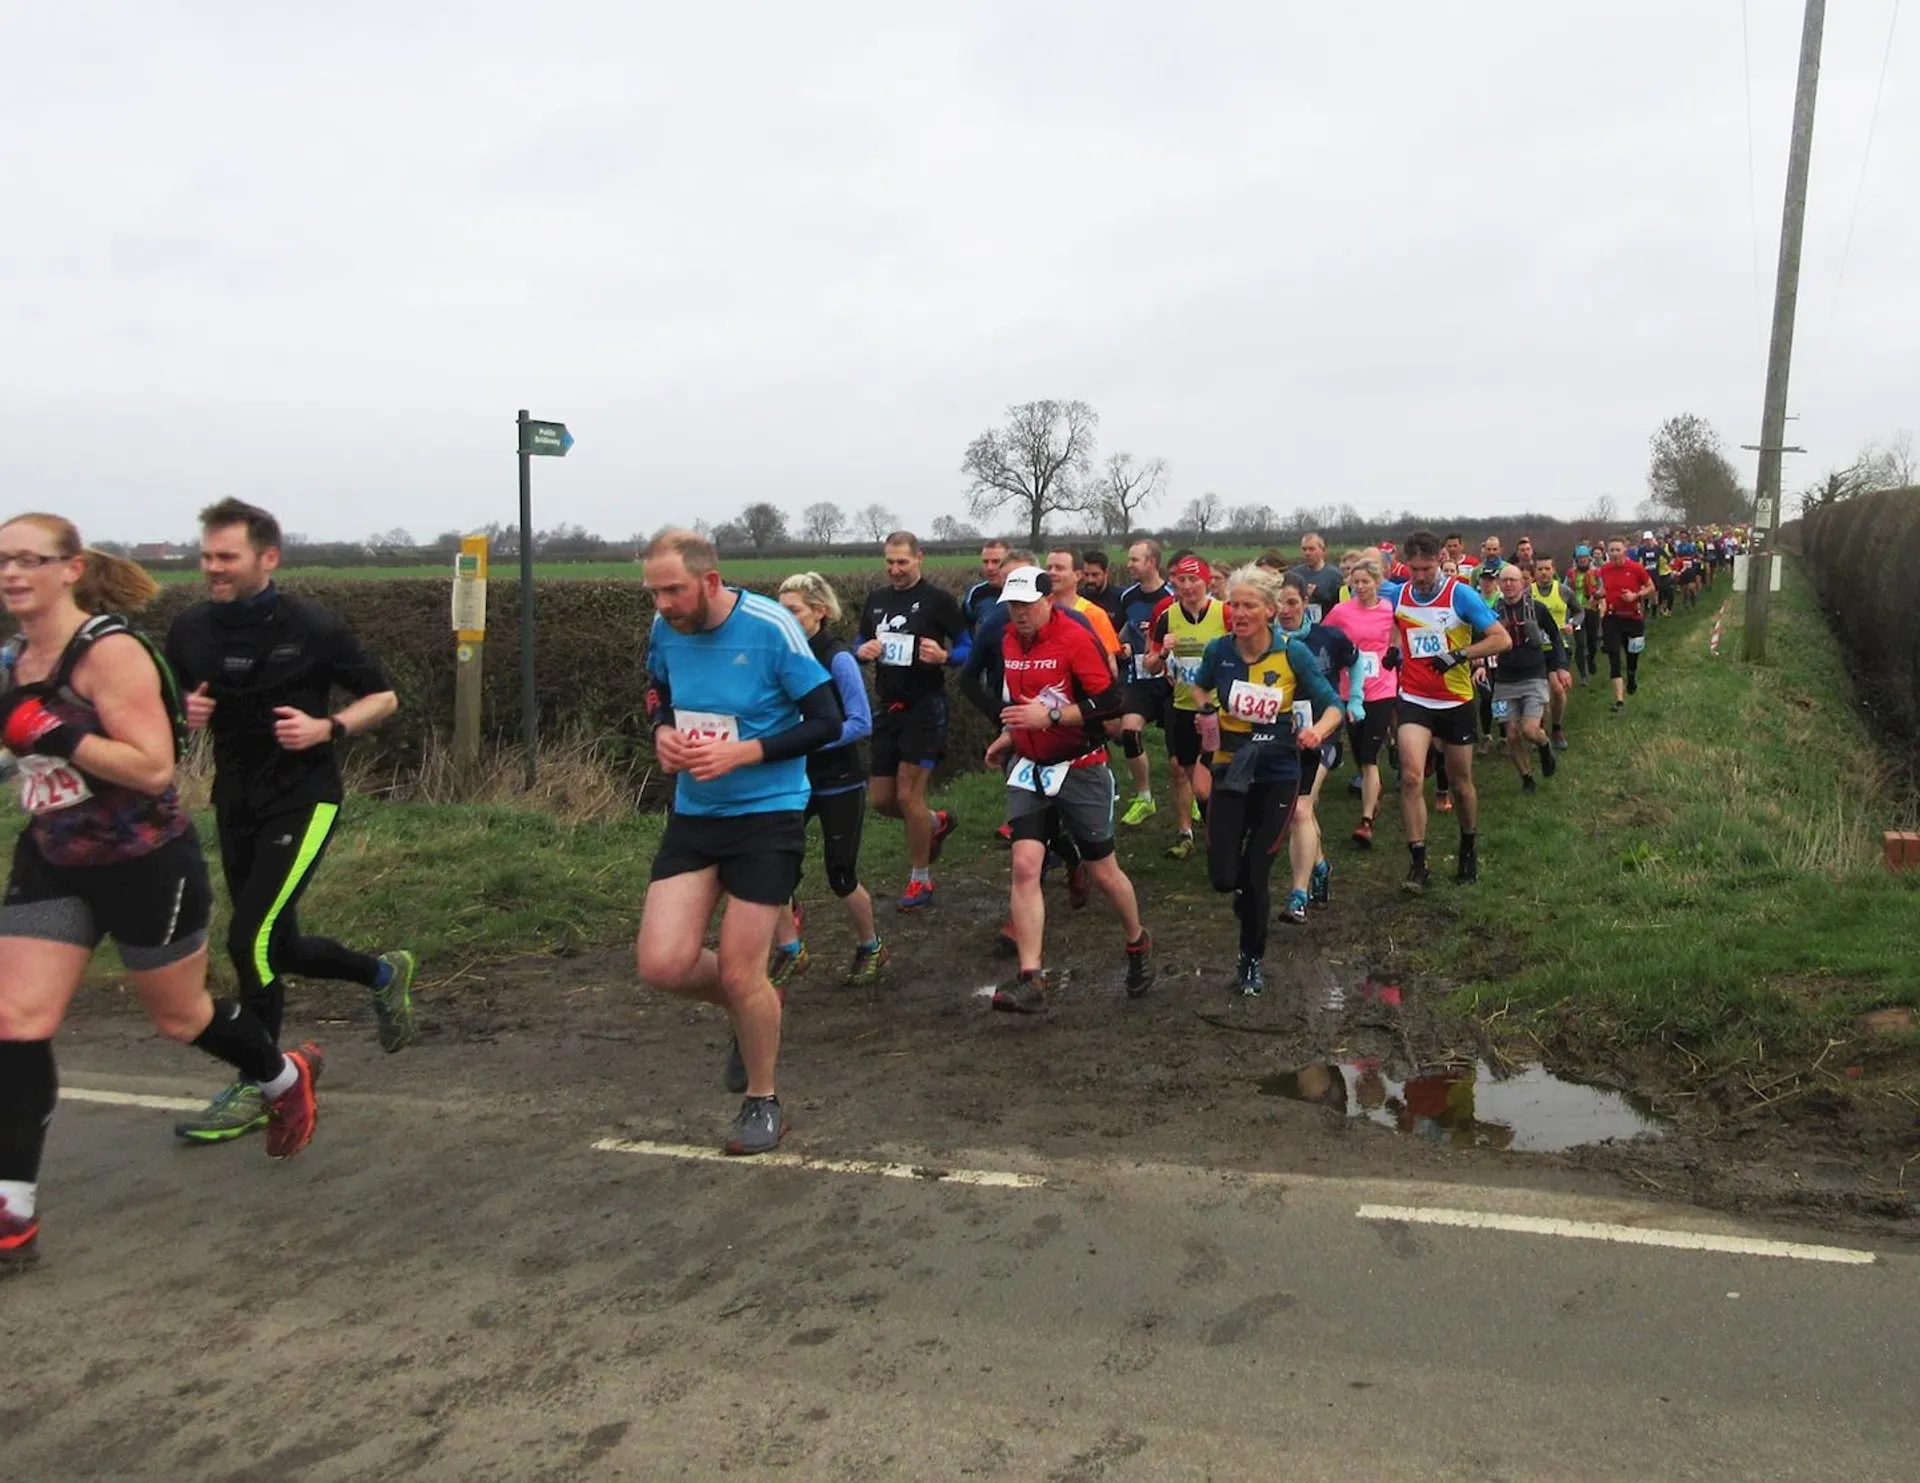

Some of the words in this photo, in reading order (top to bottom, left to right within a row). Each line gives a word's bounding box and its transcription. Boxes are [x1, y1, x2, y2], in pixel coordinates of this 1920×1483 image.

[1414, 635, 1440, 654] 768
[1033, 659, 1057, 669] TRI
[1234, 693, 1278, 719] 1343
[1018, 764, 1056, 789] 65
